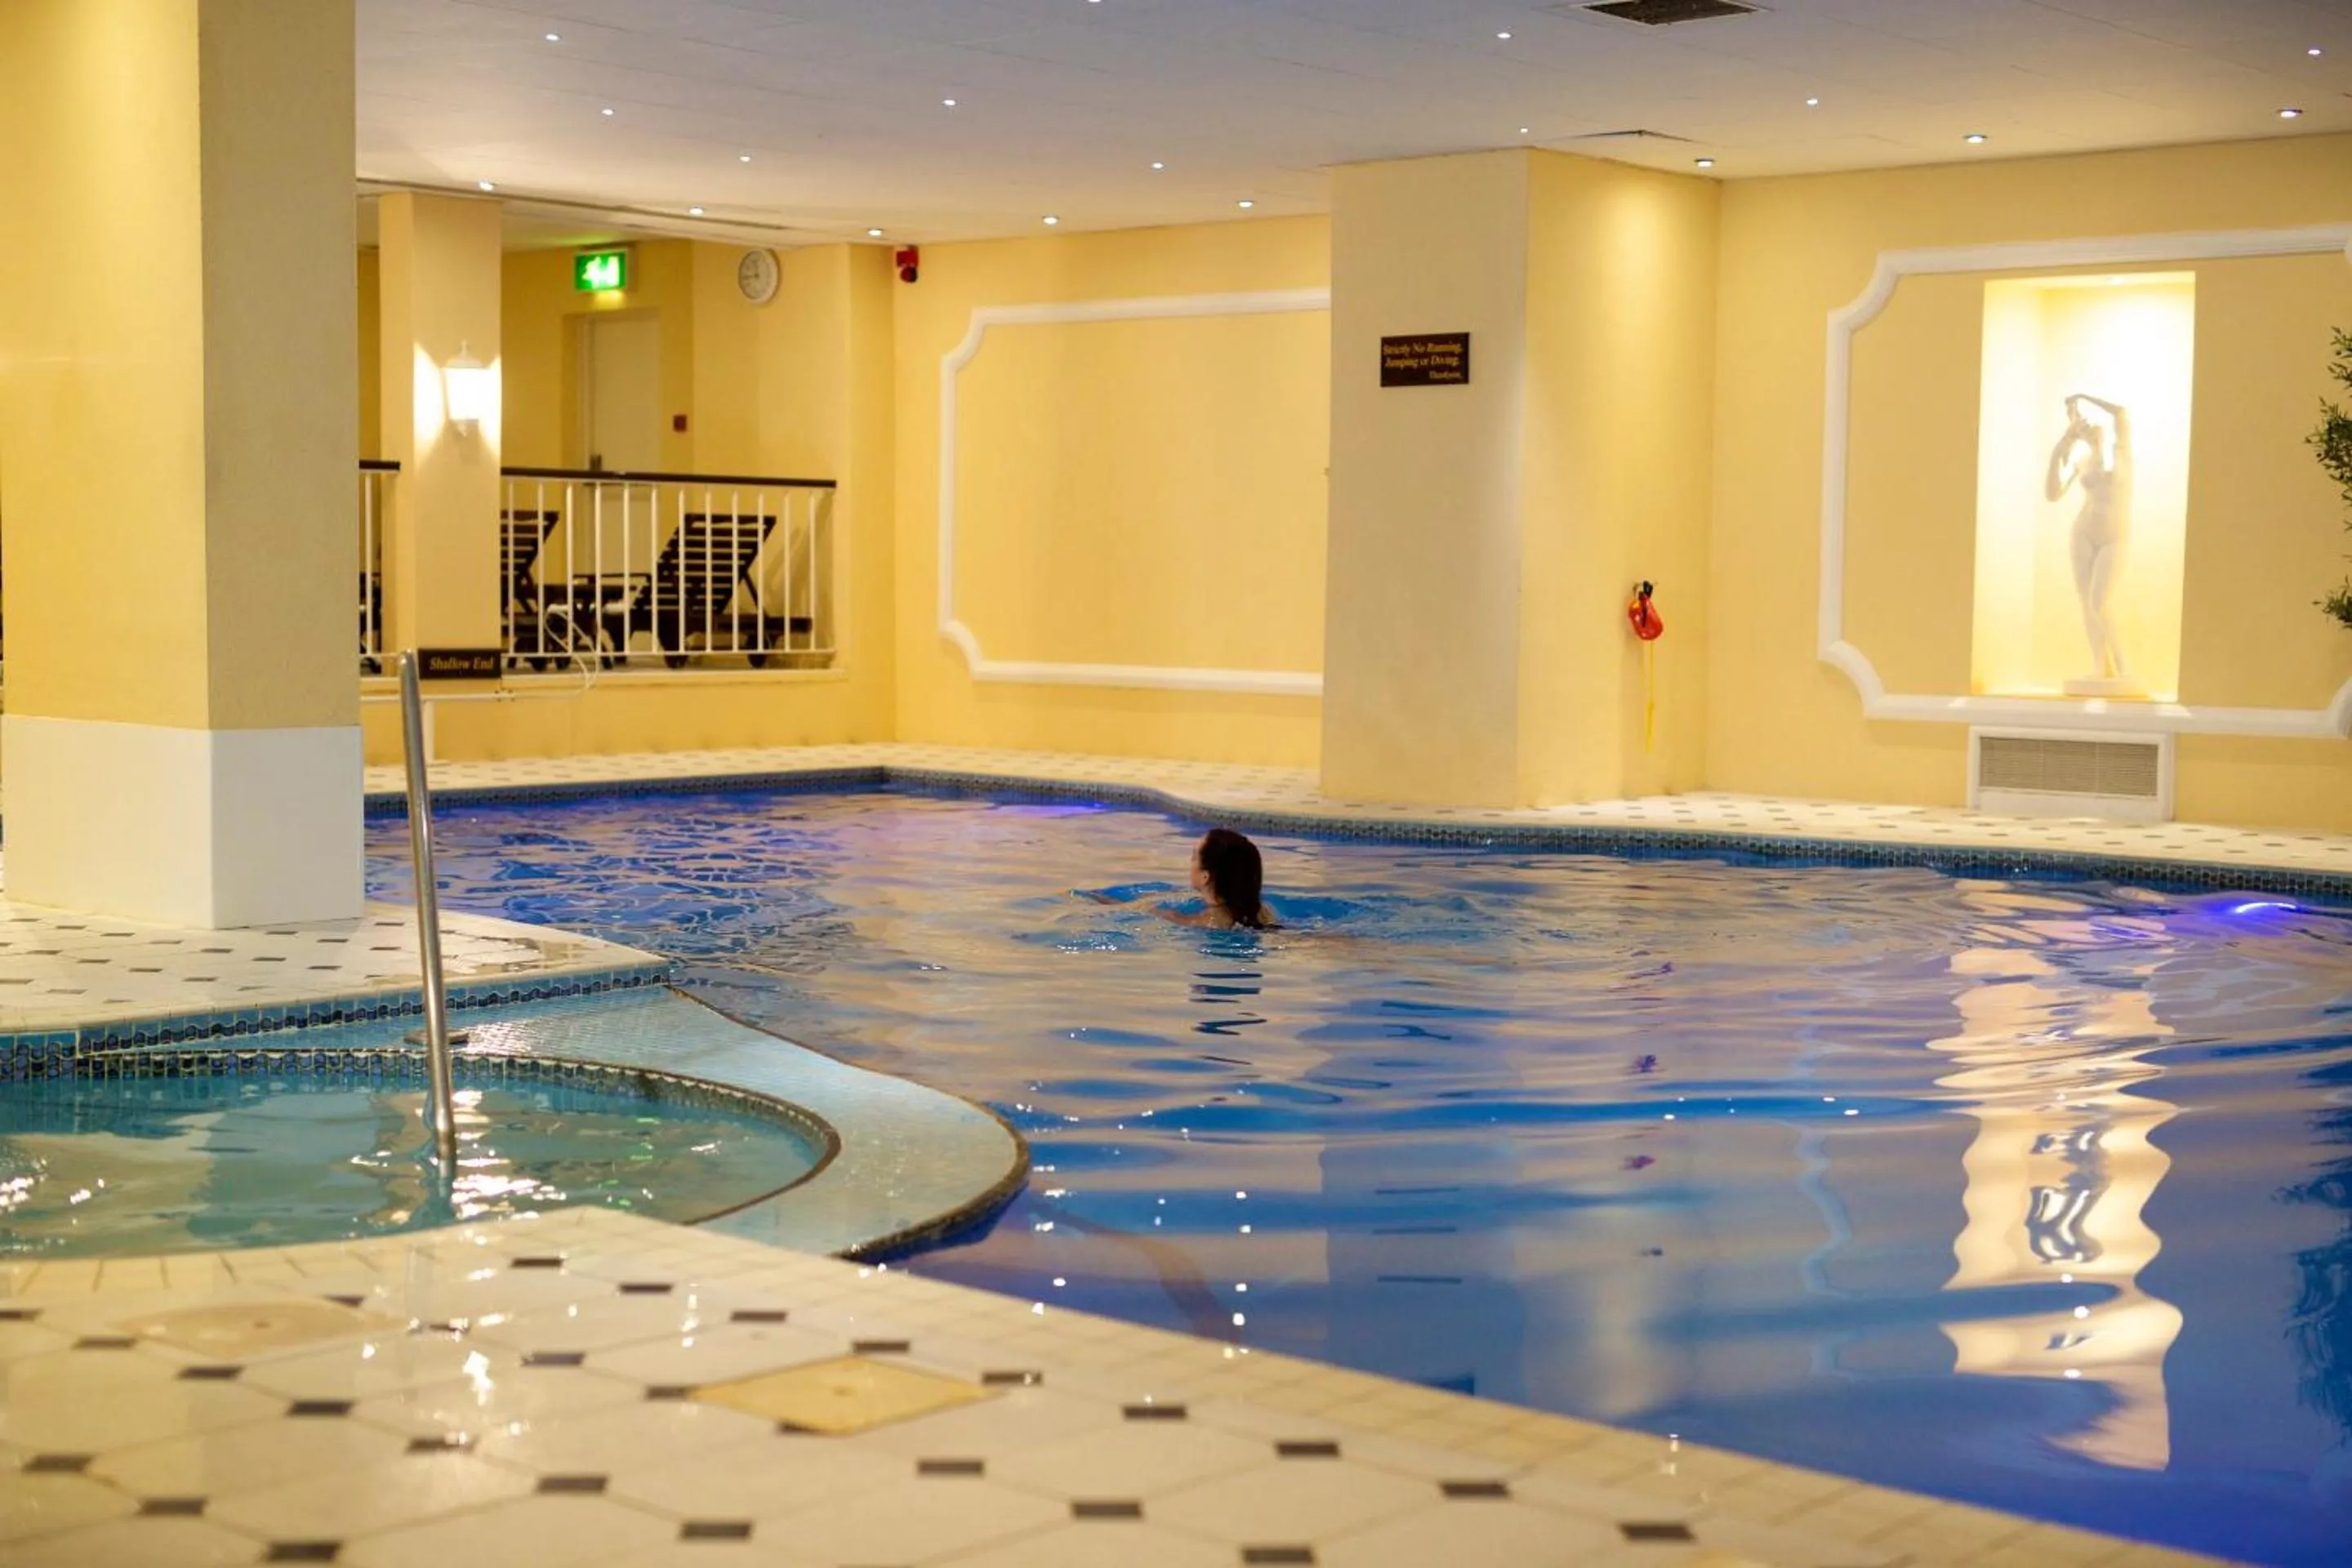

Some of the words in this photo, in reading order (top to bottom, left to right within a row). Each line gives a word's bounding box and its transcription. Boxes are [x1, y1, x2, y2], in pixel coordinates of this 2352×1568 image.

[1413, 342, 1425, 353] No
[430, 657, 470, 670] Shallow
[473, 656, 494, 670] End
